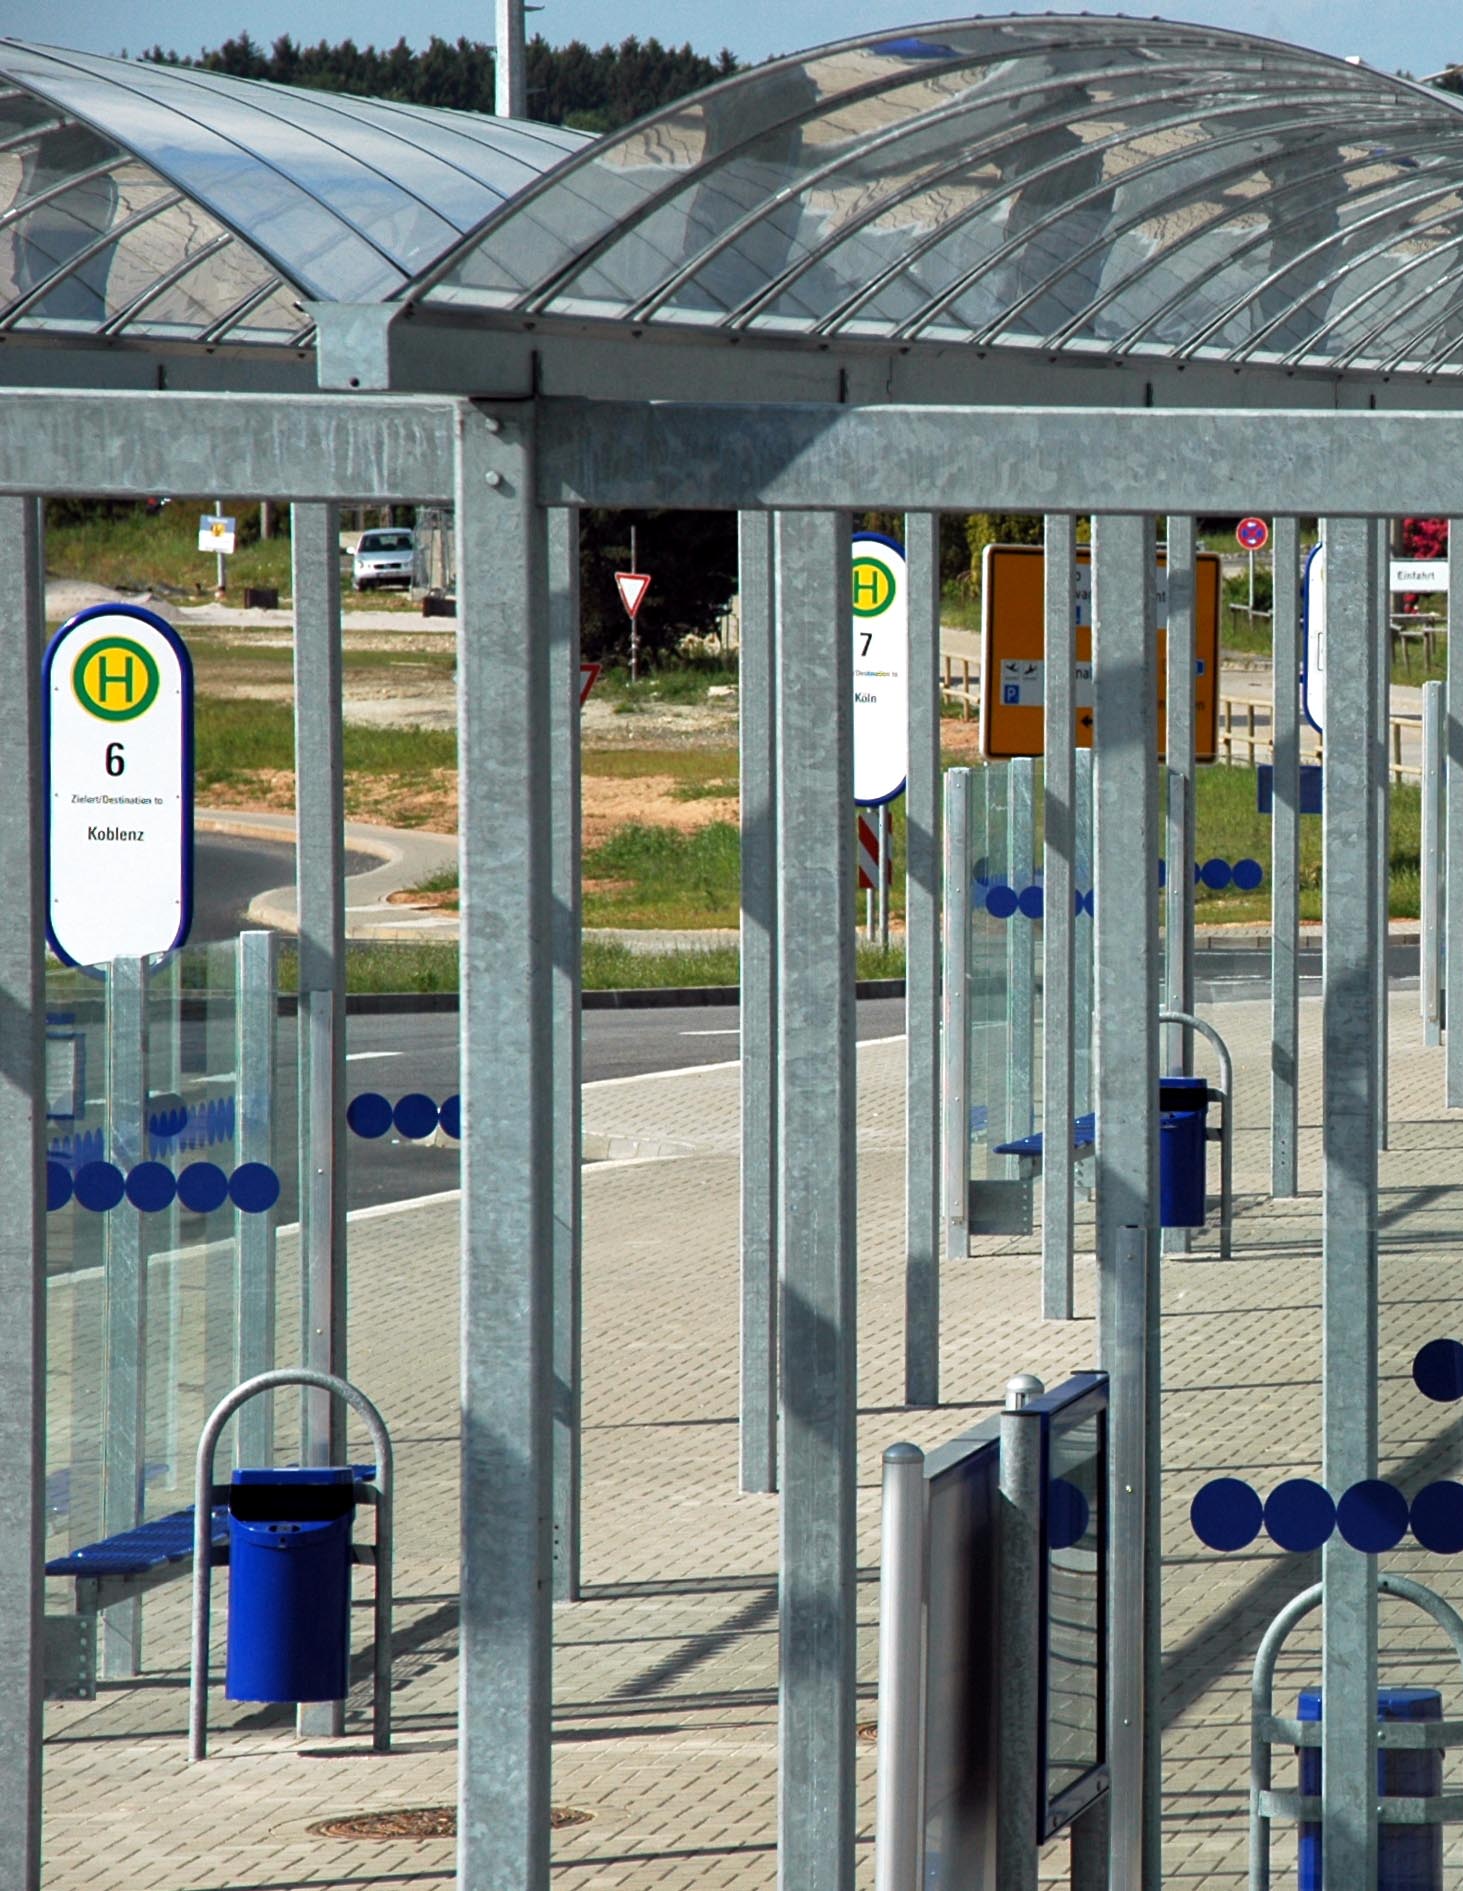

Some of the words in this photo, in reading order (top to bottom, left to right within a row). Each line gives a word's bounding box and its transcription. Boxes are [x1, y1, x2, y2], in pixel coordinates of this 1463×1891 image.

[1397, 571, 1435, 580] Einfahrt
[860, 633, 873, 657] 7
[99, 656, 133, 703] H
[855, 692, 877, 702] Köln
[105, 742, 125, 776] 6
[154, 796, 163, 805] to
[88, 826, 144, 841] Koblenz
